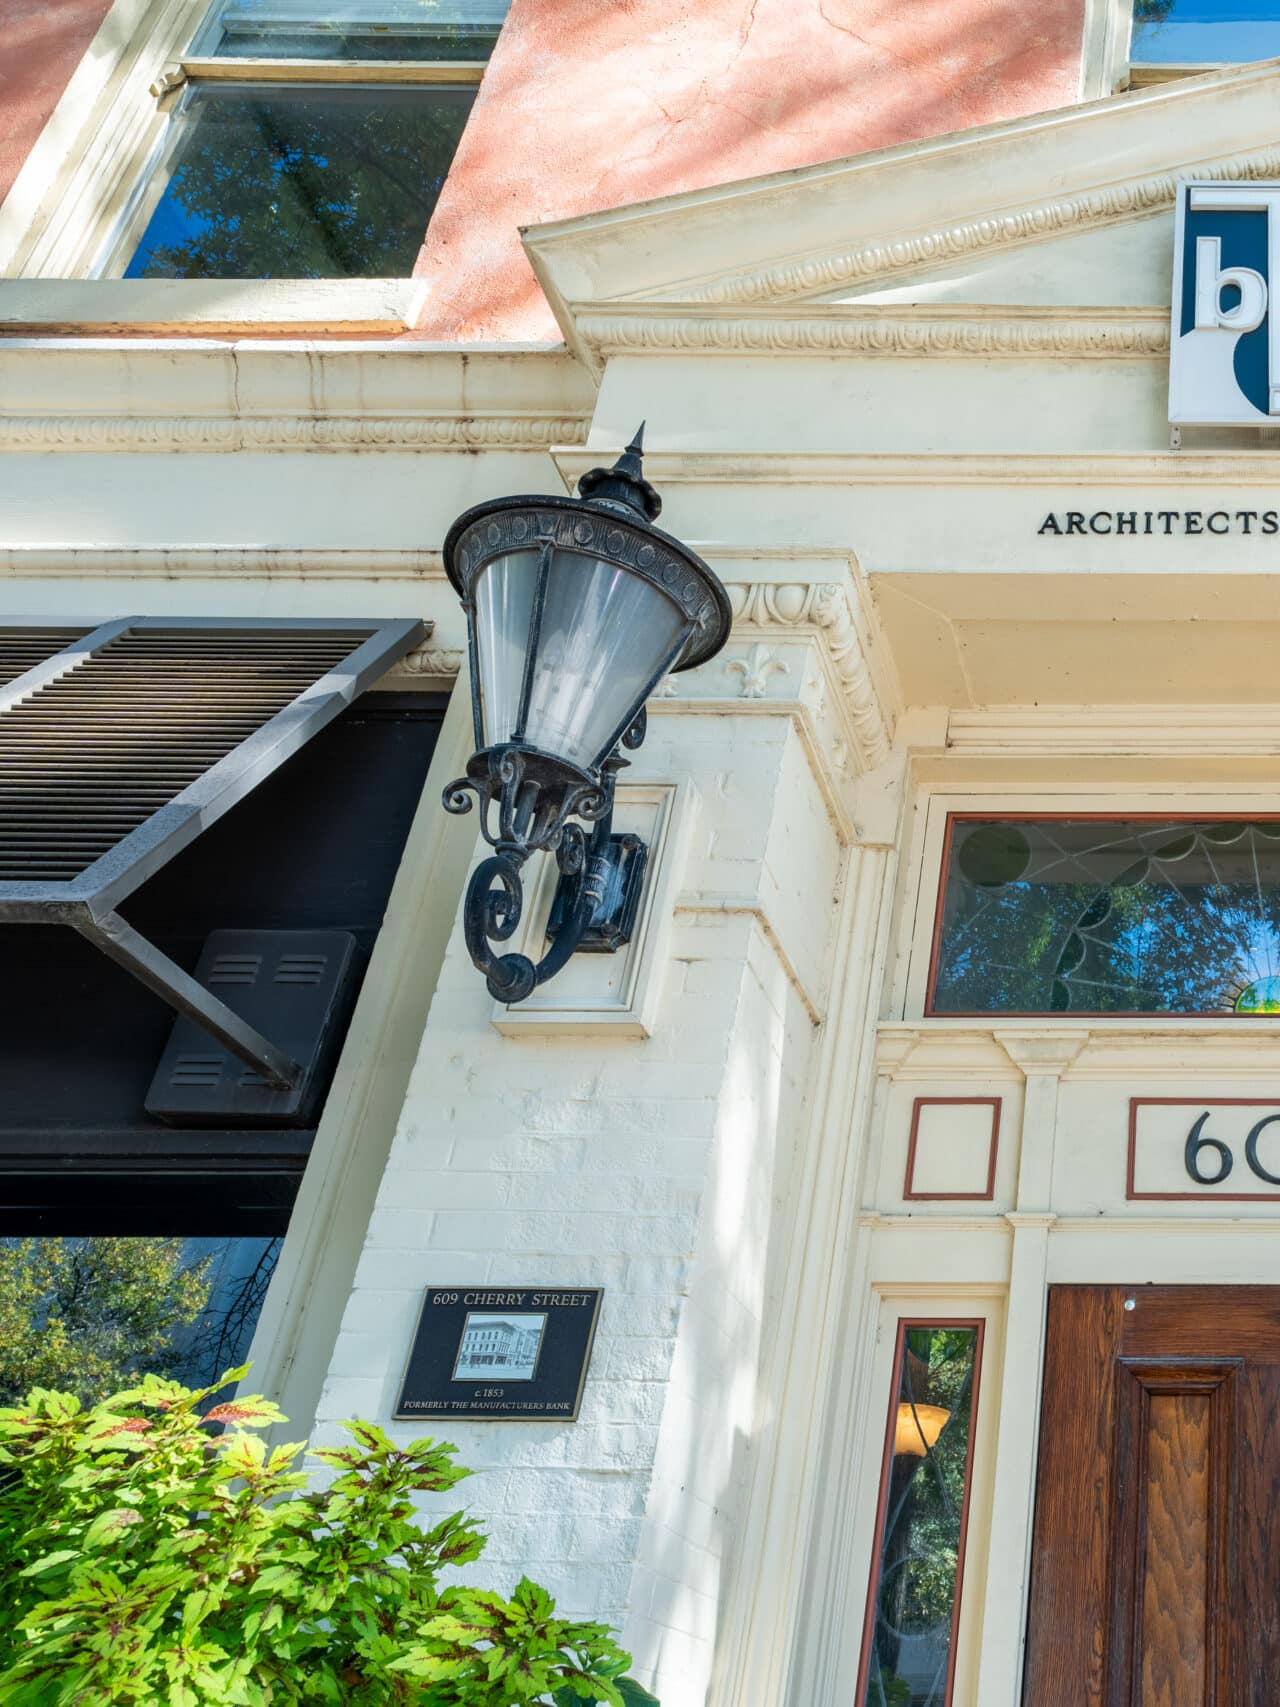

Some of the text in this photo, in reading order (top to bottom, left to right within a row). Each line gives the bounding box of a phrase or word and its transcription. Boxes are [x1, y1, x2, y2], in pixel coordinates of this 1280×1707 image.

[1037, 511, 1280, 535] ARCHITECTS
[432, 1292, 592, 1307] 609 CHERRY STREET
[403, 1400, 572, 1410] FORMERLY THE MANUFACTURERS BANK
